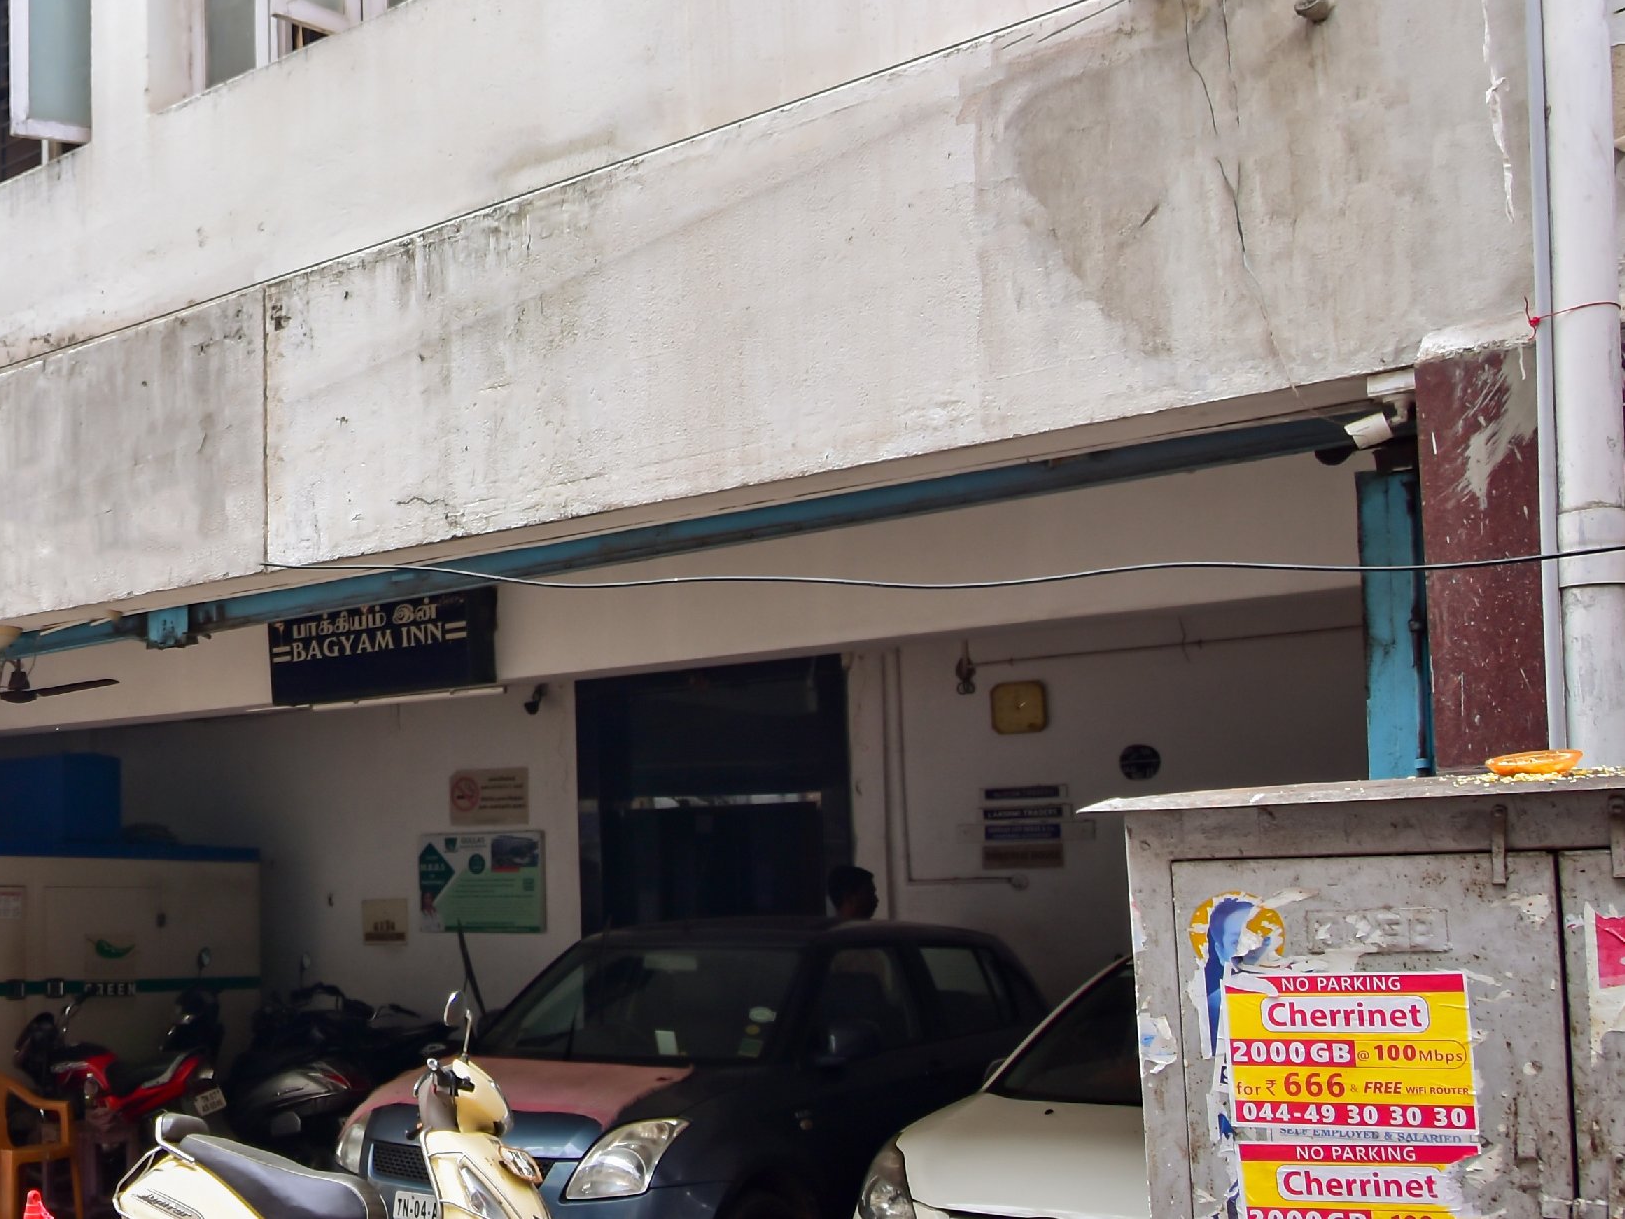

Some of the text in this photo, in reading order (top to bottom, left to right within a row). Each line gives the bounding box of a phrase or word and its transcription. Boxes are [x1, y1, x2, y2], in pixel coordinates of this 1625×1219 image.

[291, 622, 443, 662] BAGYAM INN
[1281, 976, 1401, 991] NO PARKING
[1267, 1002, 1423, 1027] Cherrinet
[1373, 1044, 1417, 1062] 100
[1419, 1049, 1464, 1065] Mbps
[1236, 1082, 1261, 1096] for
[1283, 1072, 1346, 1098] 666
[1363, 1081, 1403, 1095] FREE
[1429, 1086, 1470, 1096] ROUTER
[1242, 1102, 1468, 1127] 044-49 30 30 30
[1296, 1146, 1417, 1161] NO PARKING
[1282, 1170, 1439, 1199] Cherrinet
